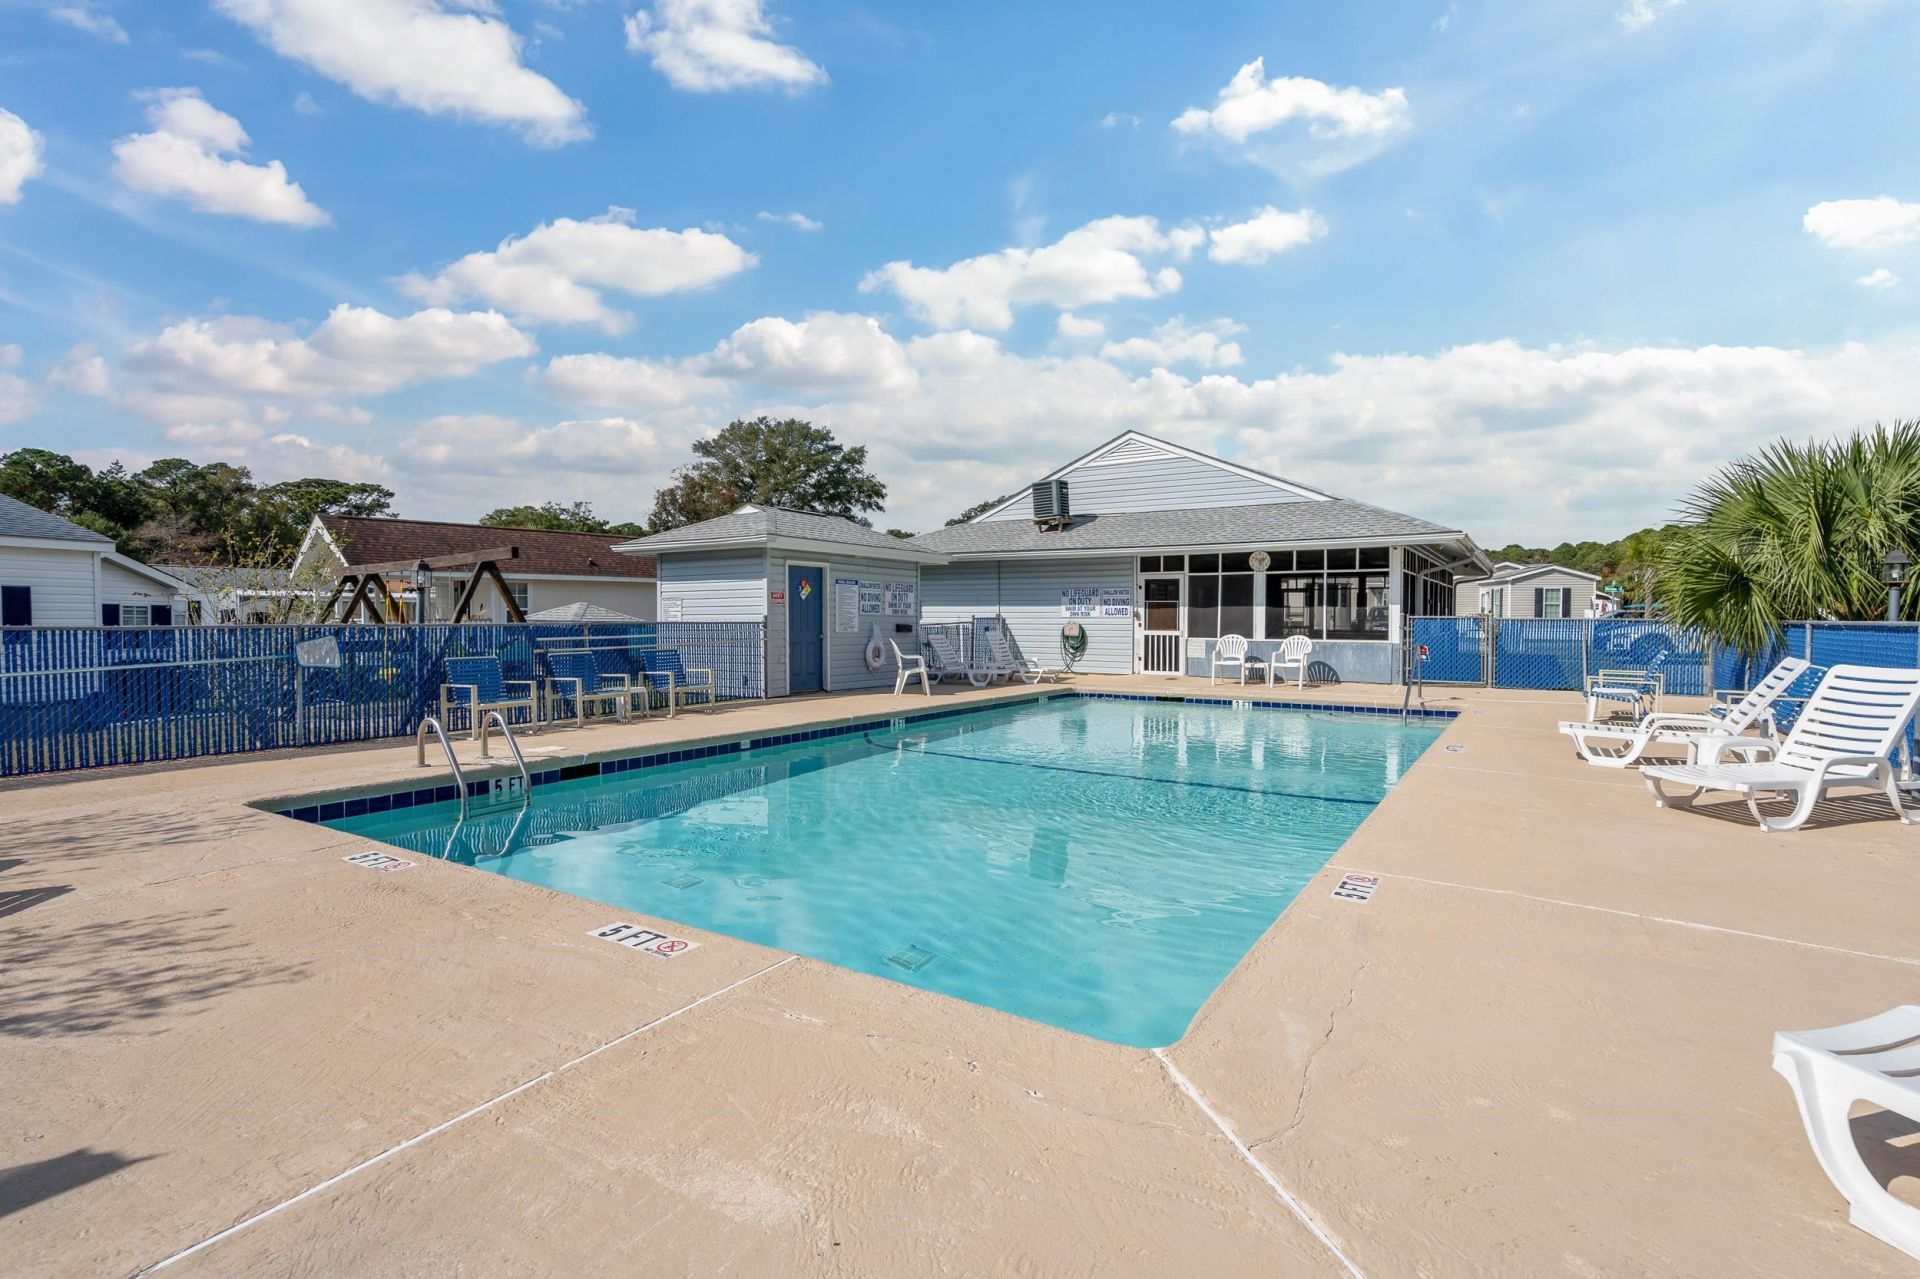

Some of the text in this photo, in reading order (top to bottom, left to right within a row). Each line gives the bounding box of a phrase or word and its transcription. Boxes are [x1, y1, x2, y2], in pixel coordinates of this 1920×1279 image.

[886, 583, 914, 593] NO LIFEGUARD
[1061, 588, 1099, 598] NO LIFEGUARD
[861, 592, 881, 603] NO DIVING
[891, 592, 908, 602] ON DUTY
[1068, 597, 1092, 606] ON DUTY
[1103, 598, 1130, 607] NO DIVING
[861, 603, 880, 614] ALLOWED
[1104, 607, 1129, 616] ALLOWED
[495, 775, 524, 793] 5 FT
[348, 852, 400, 867] 5 FT
[1334, 880, 1374, 900] 5 FT
[598, 924, 668, 947] 5 FT
